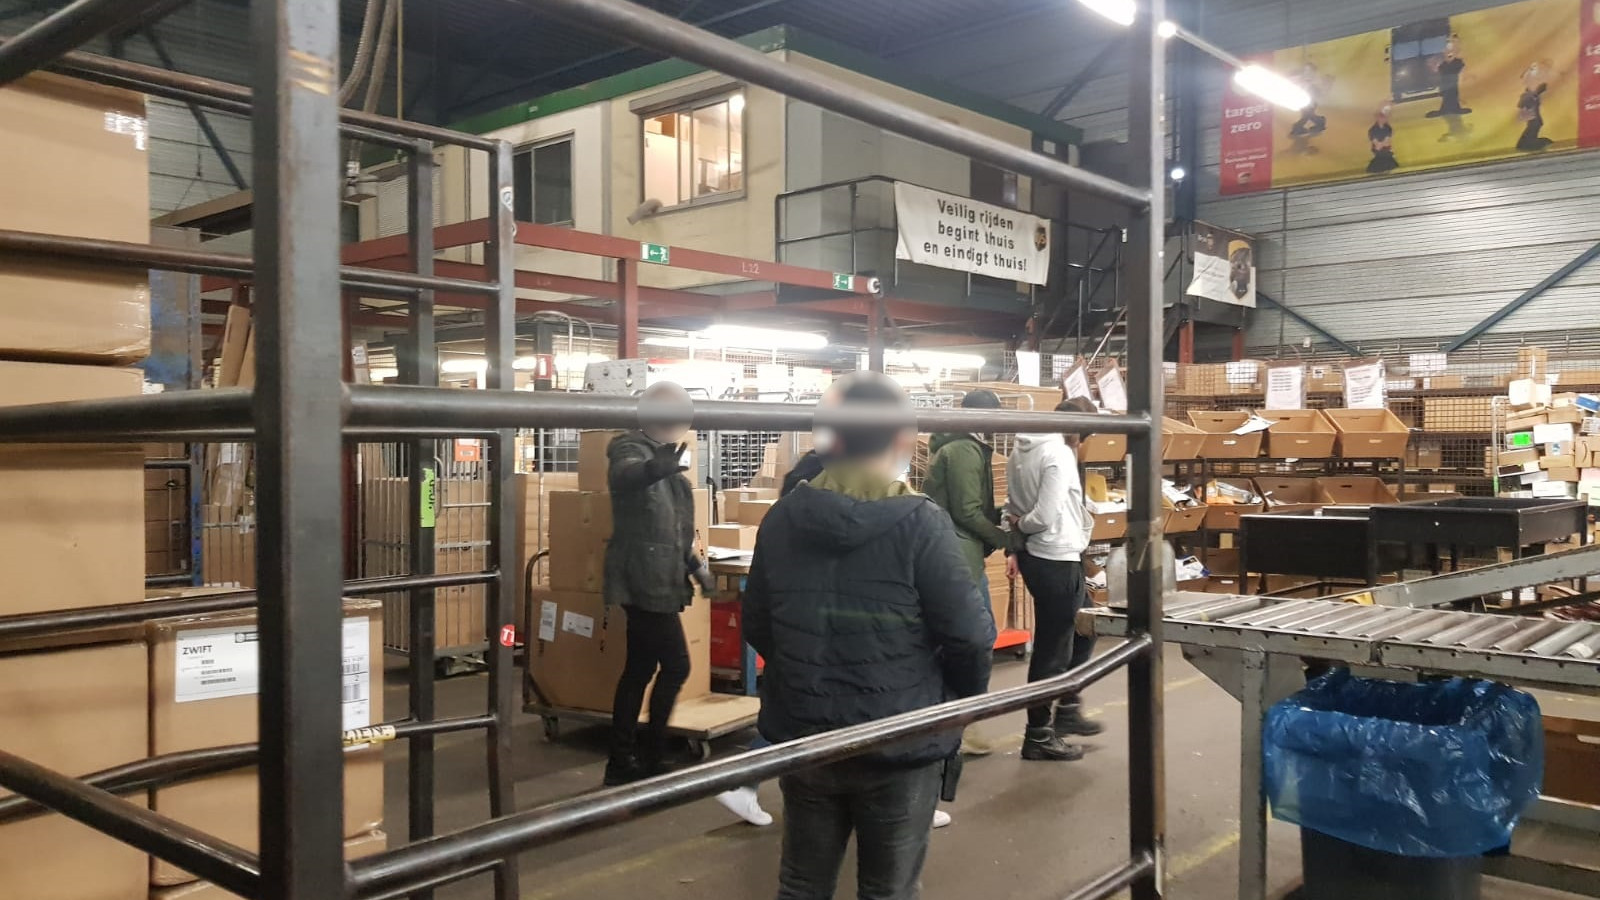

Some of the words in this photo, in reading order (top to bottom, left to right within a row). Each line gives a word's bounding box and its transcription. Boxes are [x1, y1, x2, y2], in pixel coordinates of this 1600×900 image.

[1230, 121, 1262, 134] zero
[937, 199, 975, 223] Veilig
[979, 211, 1013, 230] rijden
[938, 221, 979, 242] begint
[985, 232, 1015, 250] thuis
[924, 241, 938, 254] en
[944, 245, 988, 266] eindigt
[994, 254, 1027, 271] thuis!
[182, 645, 212, 655] ZWIFT
